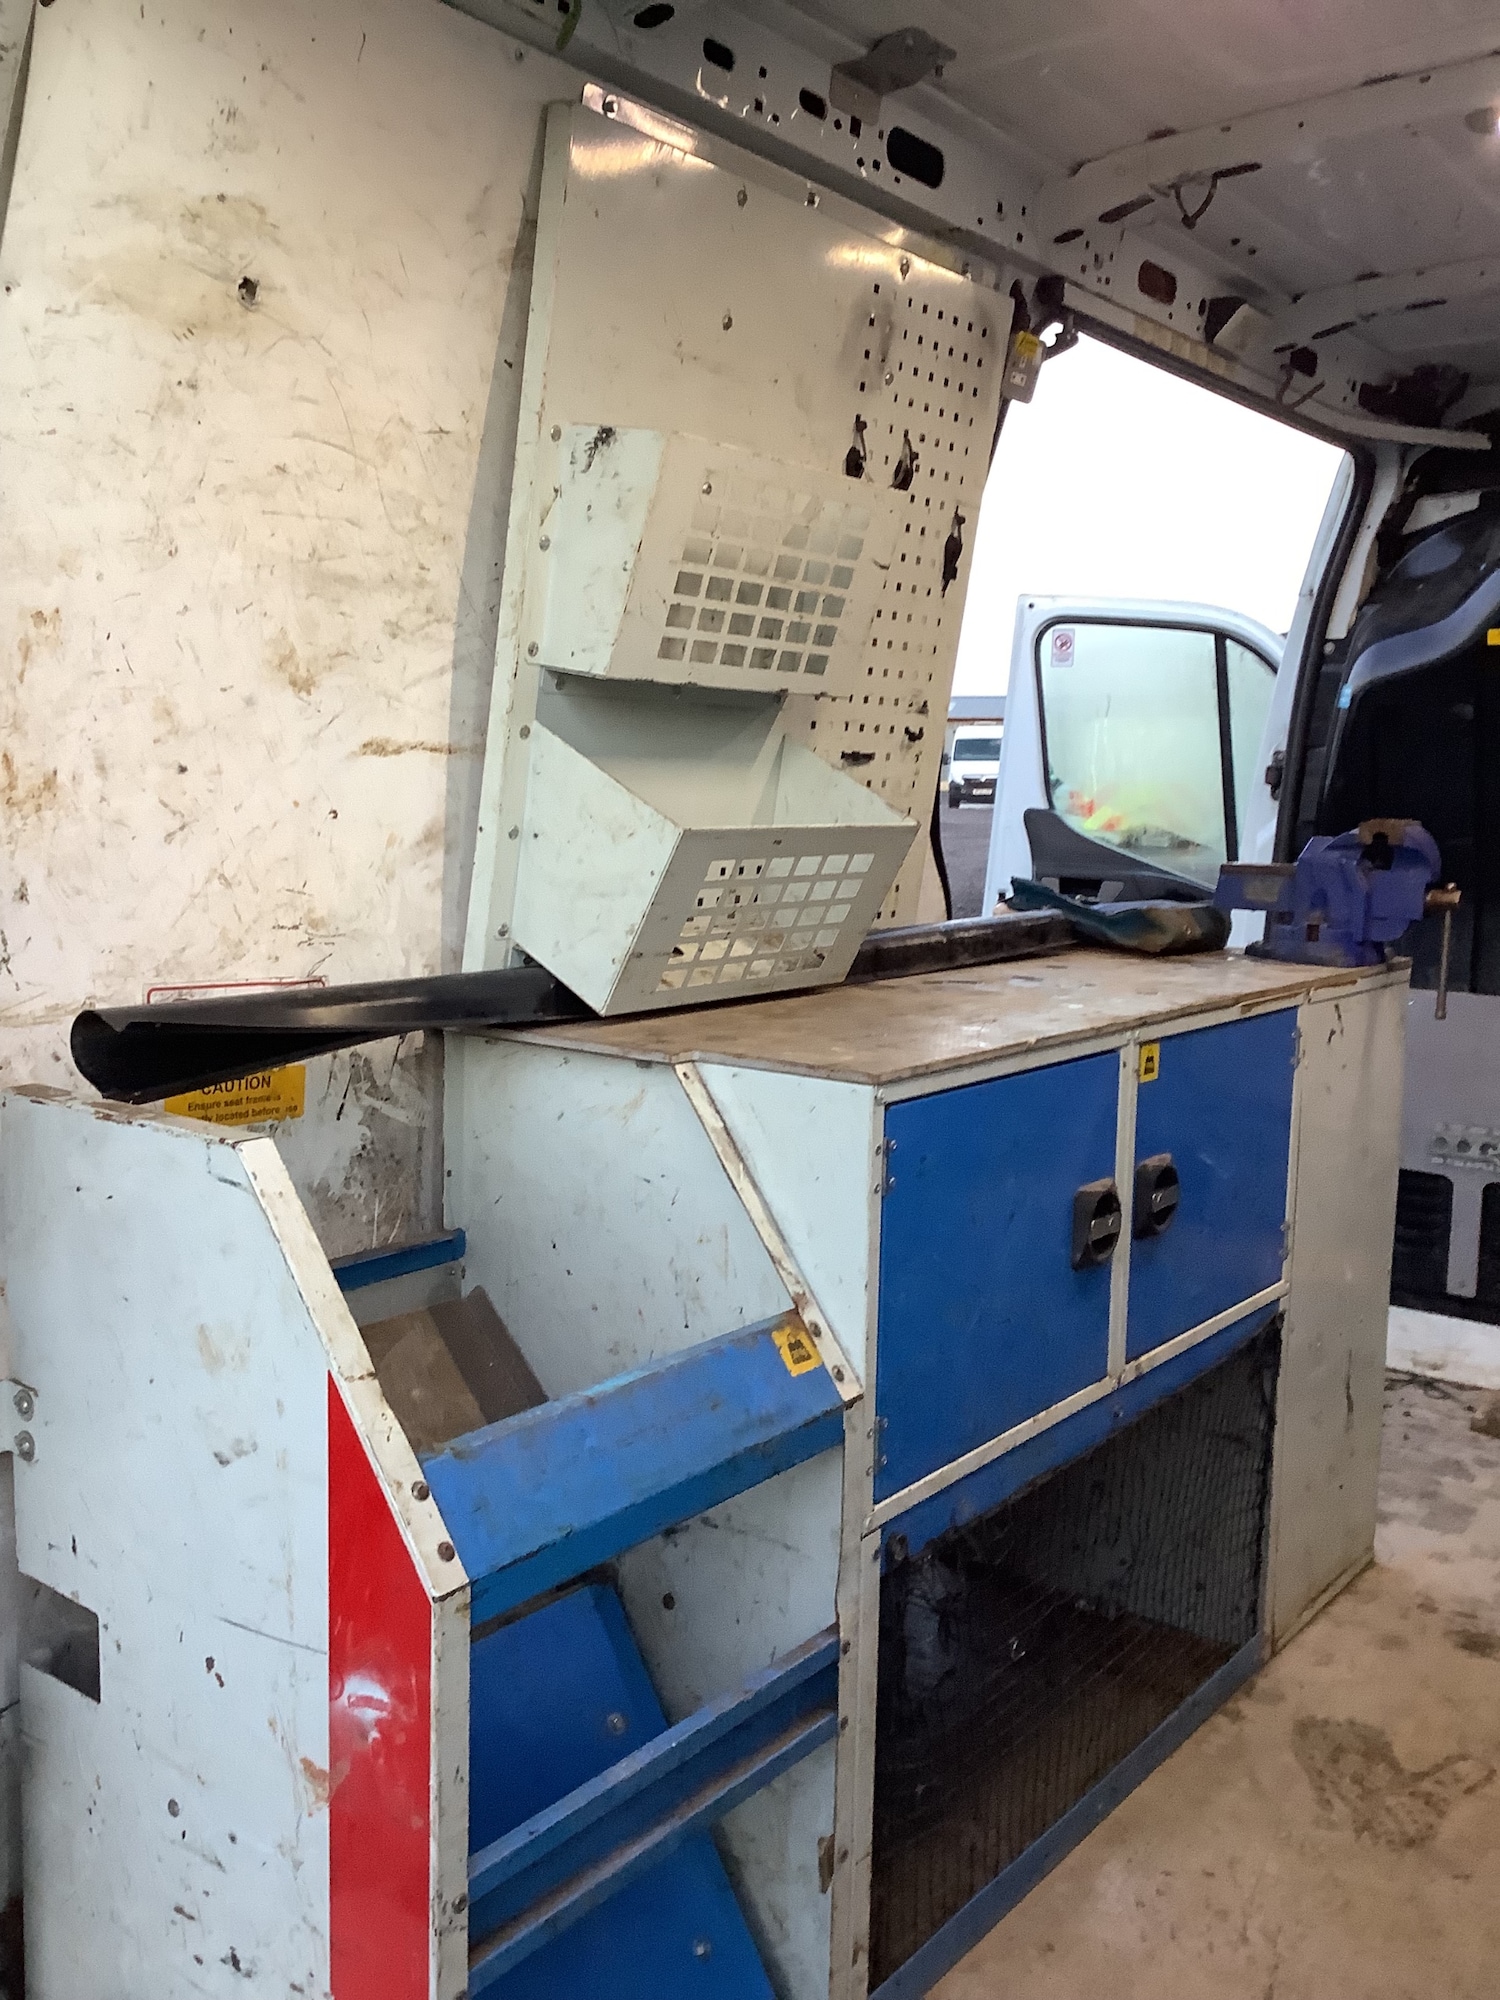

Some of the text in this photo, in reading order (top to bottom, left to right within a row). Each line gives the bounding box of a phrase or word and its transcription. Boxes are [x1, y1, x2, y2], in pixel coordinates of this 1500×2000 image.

[202, 1075, 271, 1095] CAUTION
[188, 1101, 221, 1112] Ensure
[224, 1097, 243, 1107] seat
[246, 1094, 271, 1104] frame
[215, 1110, 249, 1122] located
[251, 1106, 281, 1117] before
